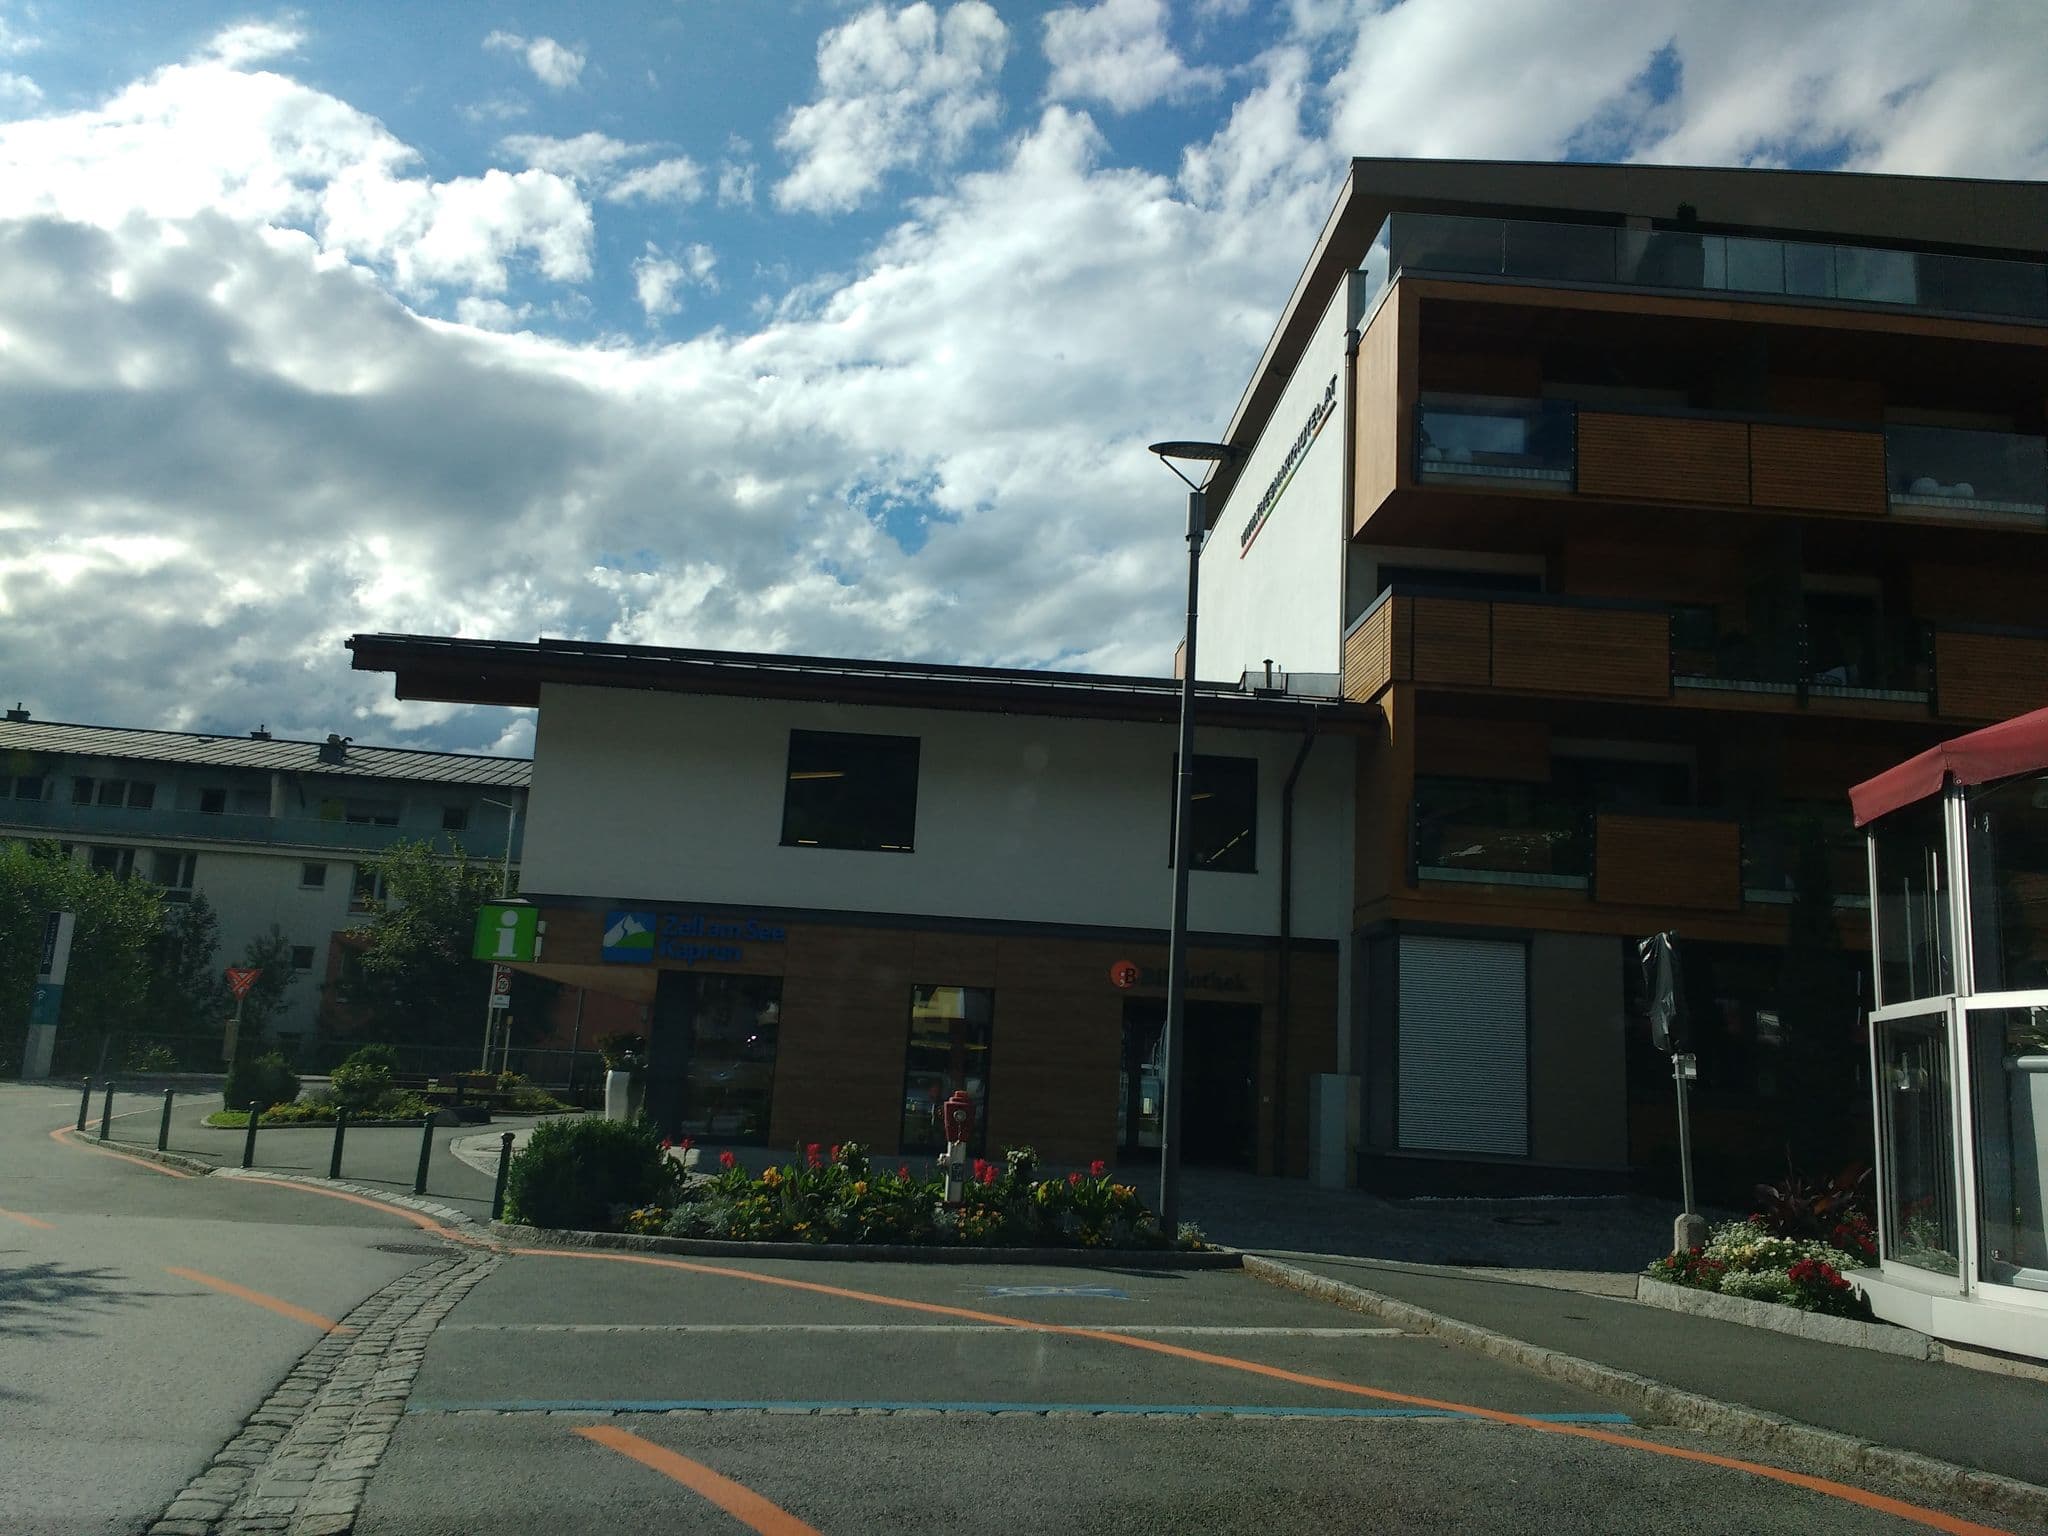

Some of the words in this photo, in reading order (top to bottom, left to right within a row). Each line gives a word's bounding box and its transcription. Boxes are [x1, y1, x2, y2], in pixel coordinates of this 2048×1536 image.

[661, 914, 705, 937] Zell
[707, 921, 741, 939] am
[744, 918, 785, 941] See
[659, 940, 742, 966] Kaprun
